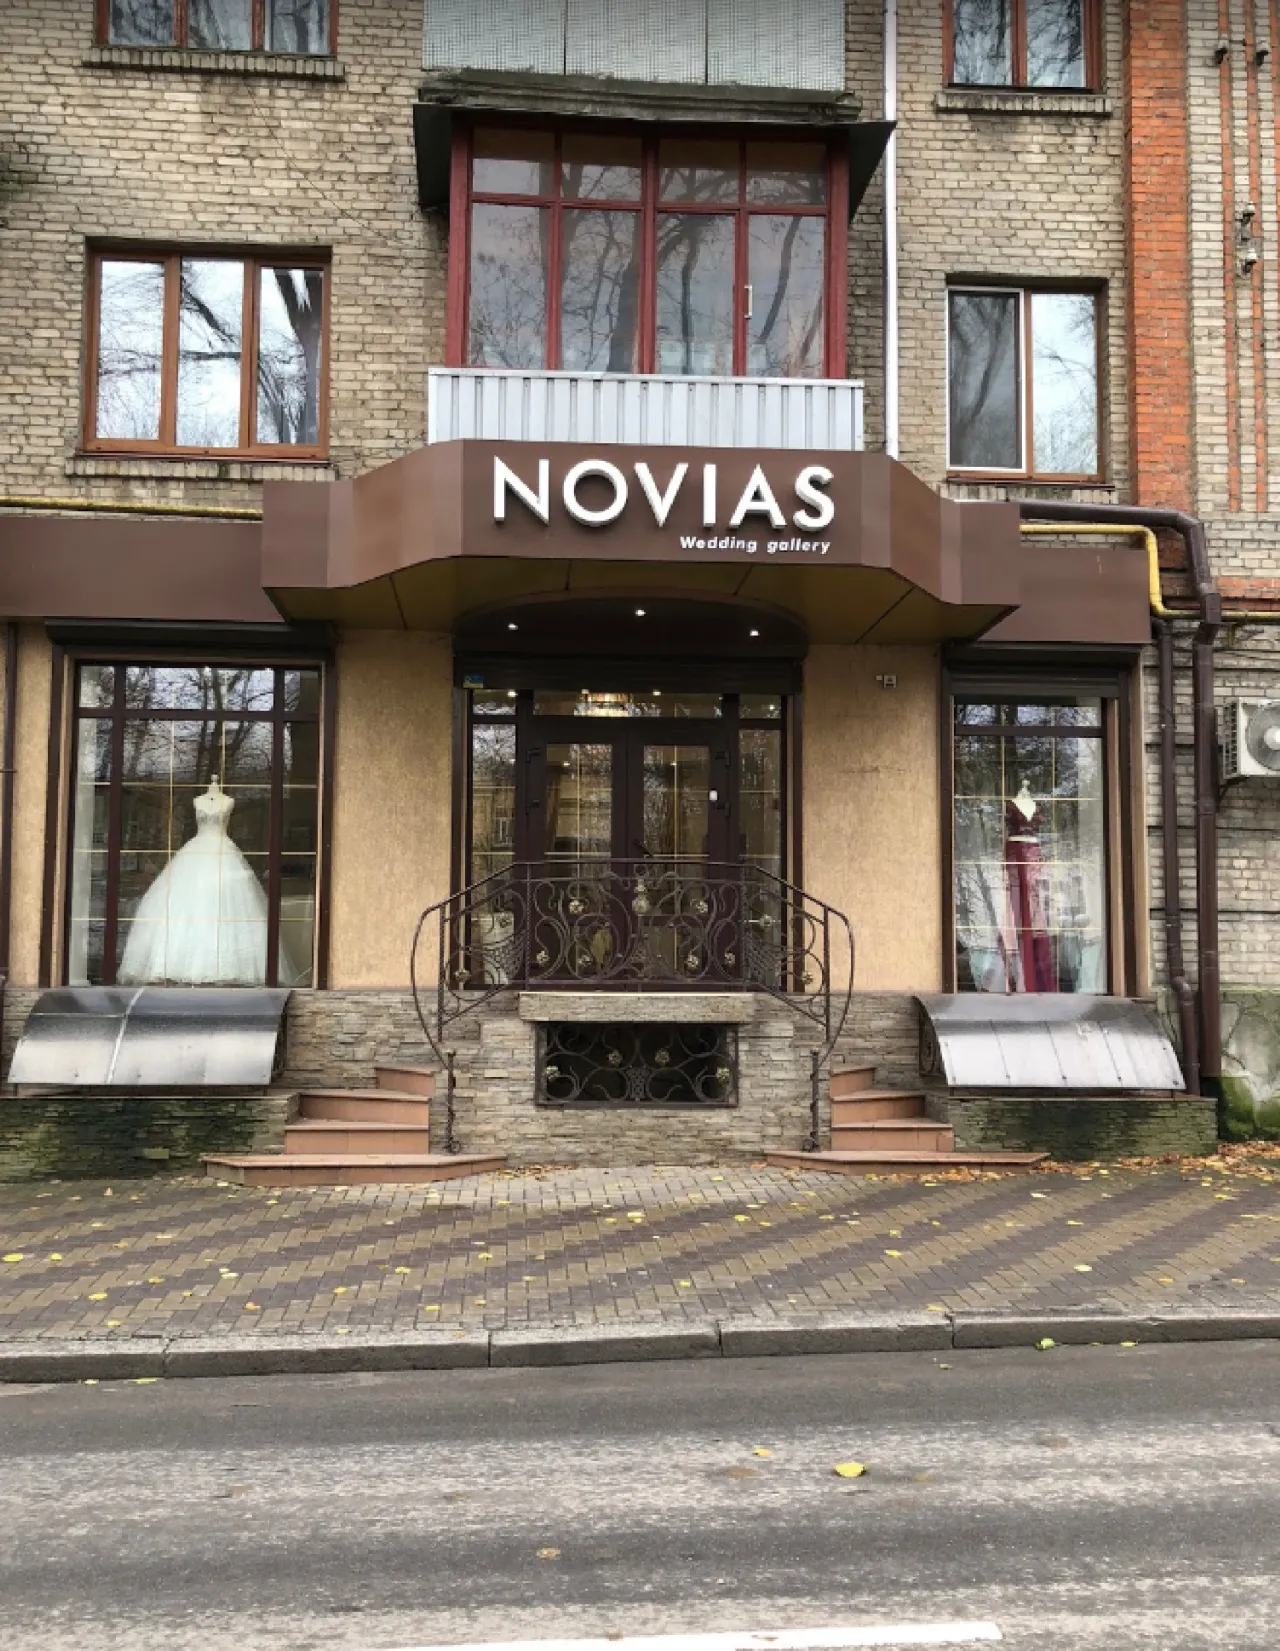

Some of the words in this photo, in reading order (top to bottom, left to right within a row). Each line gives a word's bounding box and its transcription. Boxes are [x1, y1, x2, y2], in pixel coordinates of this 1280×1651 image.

[493, 456, 836, 530] NOVIAS
[680, 536, 757, 553] Wedding
[767, 537, 831, 555] gallery
